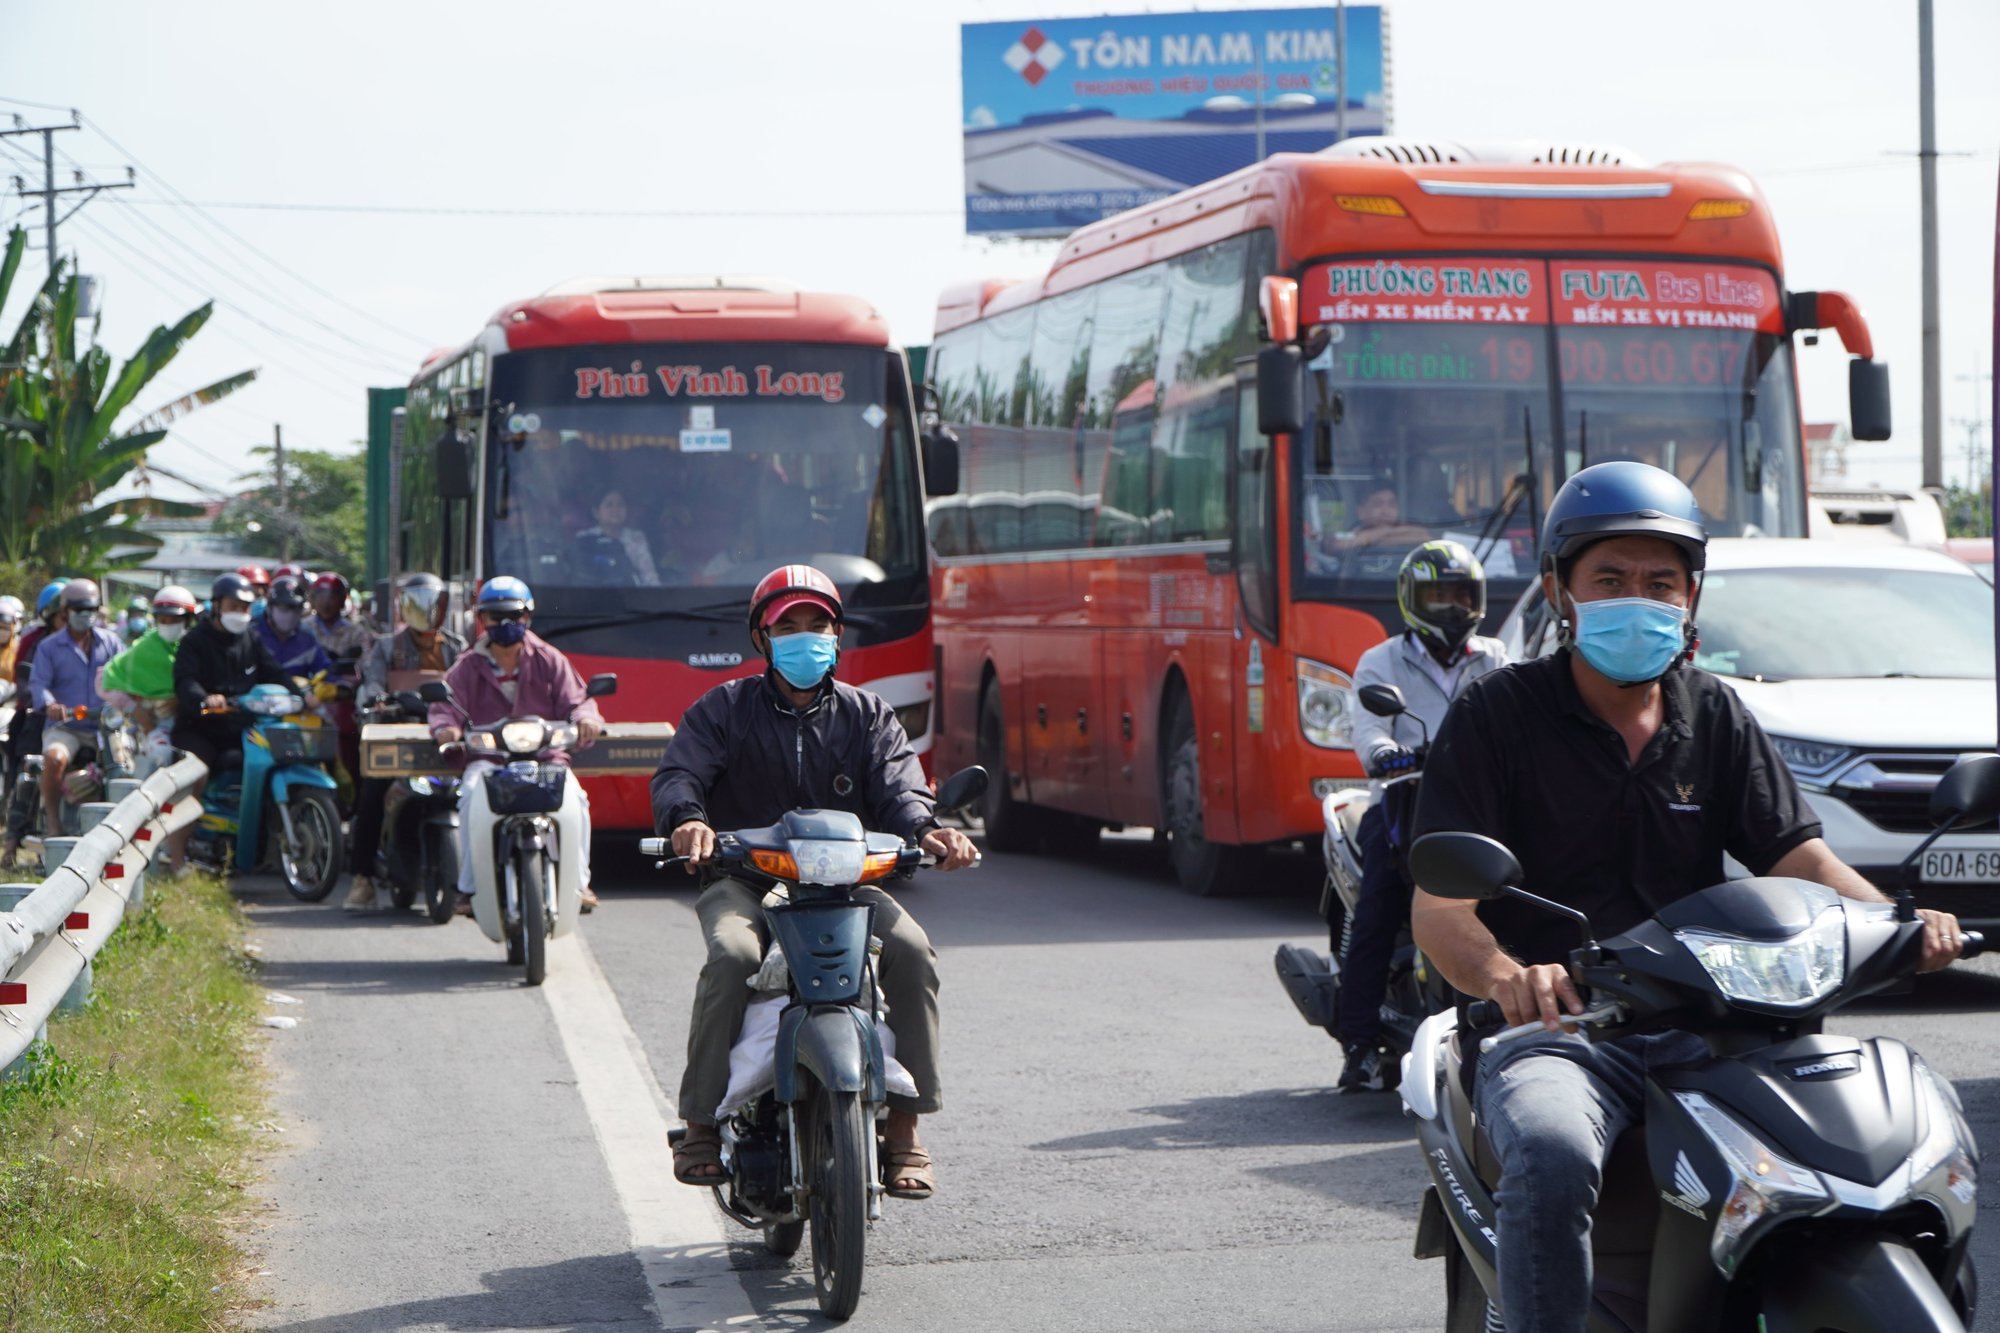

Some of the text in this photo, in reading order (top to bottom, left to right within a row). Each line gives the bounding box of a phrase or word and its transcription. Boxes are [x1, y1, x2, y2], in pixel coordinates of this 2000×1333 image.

[1070, 29, 1336, 69] TÔN NAM KIM
[1441, 266, 1531, 297] TRANG
[1561, 269, 1765, 307] FUTA Bus Lines
[1320, 299, 1368, 320] BẾN
[1375, 304, 1408, 319] XE
[1479, 304, 1530, 321] TÂY
[1572, 303, 1757, 329] BẾN XE VỊ THANH
[576, 360, 845, 402] Phủ Vĩnh Long
[688, 653, 742, 666] SAMCO
[1926, 852, 2000, 878] 60A-69
[1794, 1061, 1857, 1076] HONDA
[1430, 1148, 1483, 1225] FUTURE
[1661, 1189, 1708, 1221] HONDA
